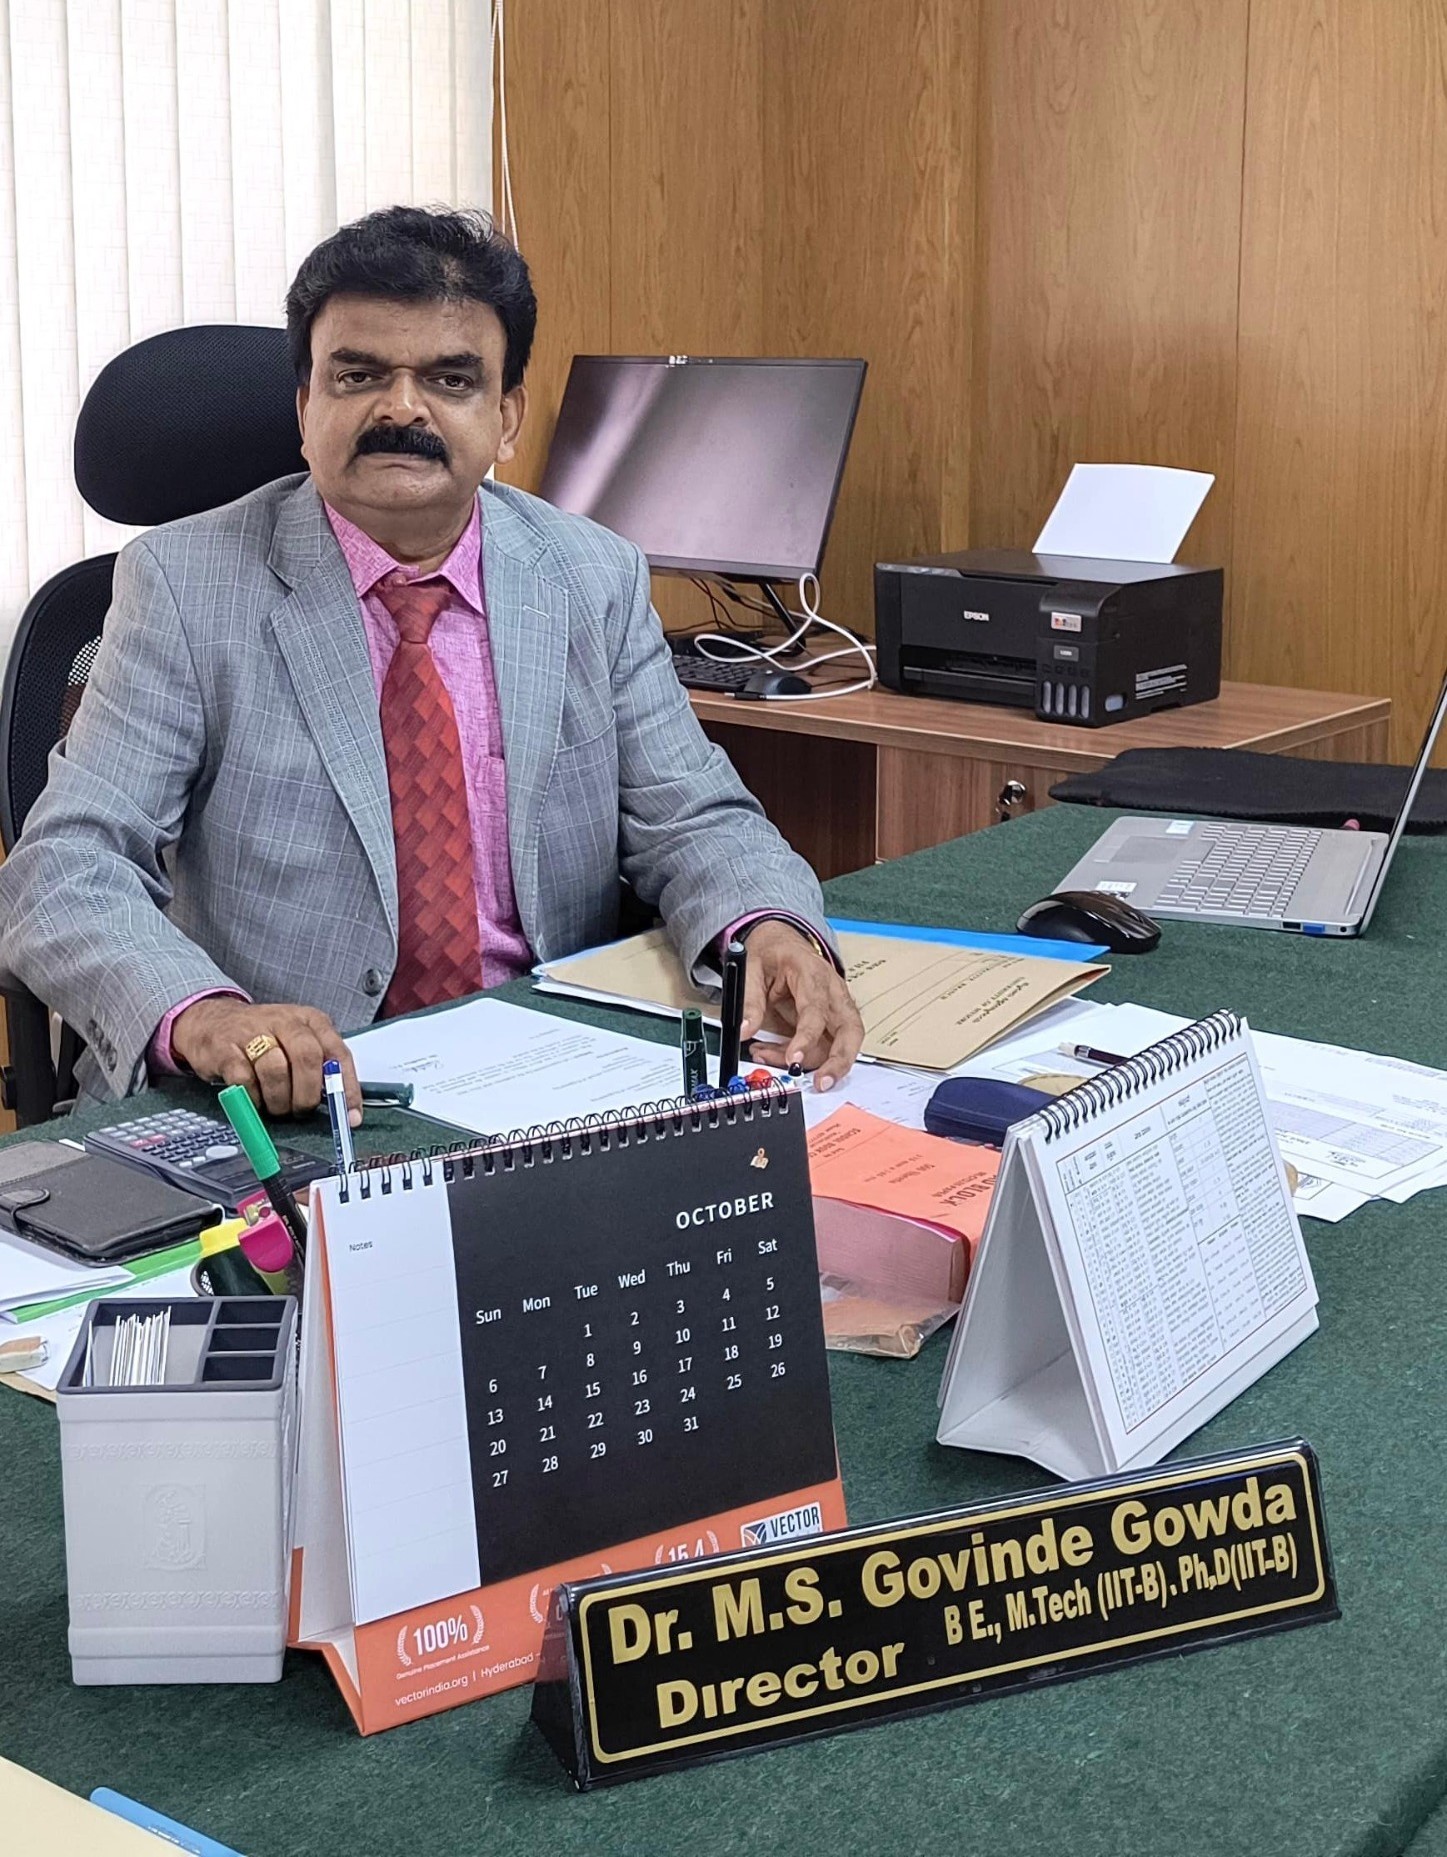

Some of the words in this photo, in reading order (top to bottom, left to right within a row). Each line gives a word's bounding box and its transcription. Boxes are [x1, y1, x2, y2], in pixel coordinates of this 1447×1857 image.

[675, 1191, 774, 1230] OCTOBER
[349, 1240, 373, 1252] Notes
[475, 1308, 502, 1325] Sun
[522, 1296, 551, 1313] Mon
[573, 1284, 599, 1300] Tue
[617, 1268, 646, 1289] Wed
[665, 1260, 691, 1277] Thu
[716, 1247, 733, 1265] Fri
[757, 1238, 778, 1255] Sat
[584, 1323, 593, 1338] 1
[630, 1311, 640, 1326] 2
[676, 1299, 685, 1314] 3
[722, 1287, 731, 1301] 4
[766, 1276, 775, 1291] 5
[487, 1408, 504, 1426] 13
[537, 1394, 553, 1412] 14
[585, 1381, 601, 1399] 15
[632, 1368, 648, 1386] 16
[678, 1356, 693, 1374] 17
[724, 1344, 739, 1361] 18
[768, 1333, 783, 1350] 19
[488, 1378, 498, 1394] 6
[537, 1365, 547, 1380] 7
[586, 1352, 595, 1367] 8
[632, 1340, 642, 1355] 9
[675, 1327, 691, 1345] 10
[722, 1316, 737, 1332] 11
[765, 1304, 781, 1321] 12
[489, 1438, 507, 1457] 20
[539, 1425, 557, 1443] 21
[587, 1411, 605, 1429] 22
[634, 1398, 651, 1416] 23
[679, 1386, 696, 1403] 24
[726, 1373, 742, 1390] 25
[770, 1361, 786, 1378] 26
[492, 1469, 509, 1488] 27
[541, 1455, 559, 1473] 28
[590, 1441, 607, 1459] 29
[637, 1428, 653, 1446] 30
[683, 1416, 699, 1432] 31
[770, 1506, 820, 1538] VECTOR
[607, 1603, 693, 1665] Dr.
[711, 1566, 843, 1642] M.S.
[861, 1517, 1094, 1608] Govinde
[1110, 1477, 1297, 1555] Gowda
[413, 1614, 468, 1656] 100%
[944, 1604, 963, 1645] B
[1005, 1578, 1092, 1632] M.Tech
[394, 1675, 468, 1706] vectorindia.org
[481, 1652, 533, 1678] Hyderabad
[656, 1642, 905, 1729] Director
